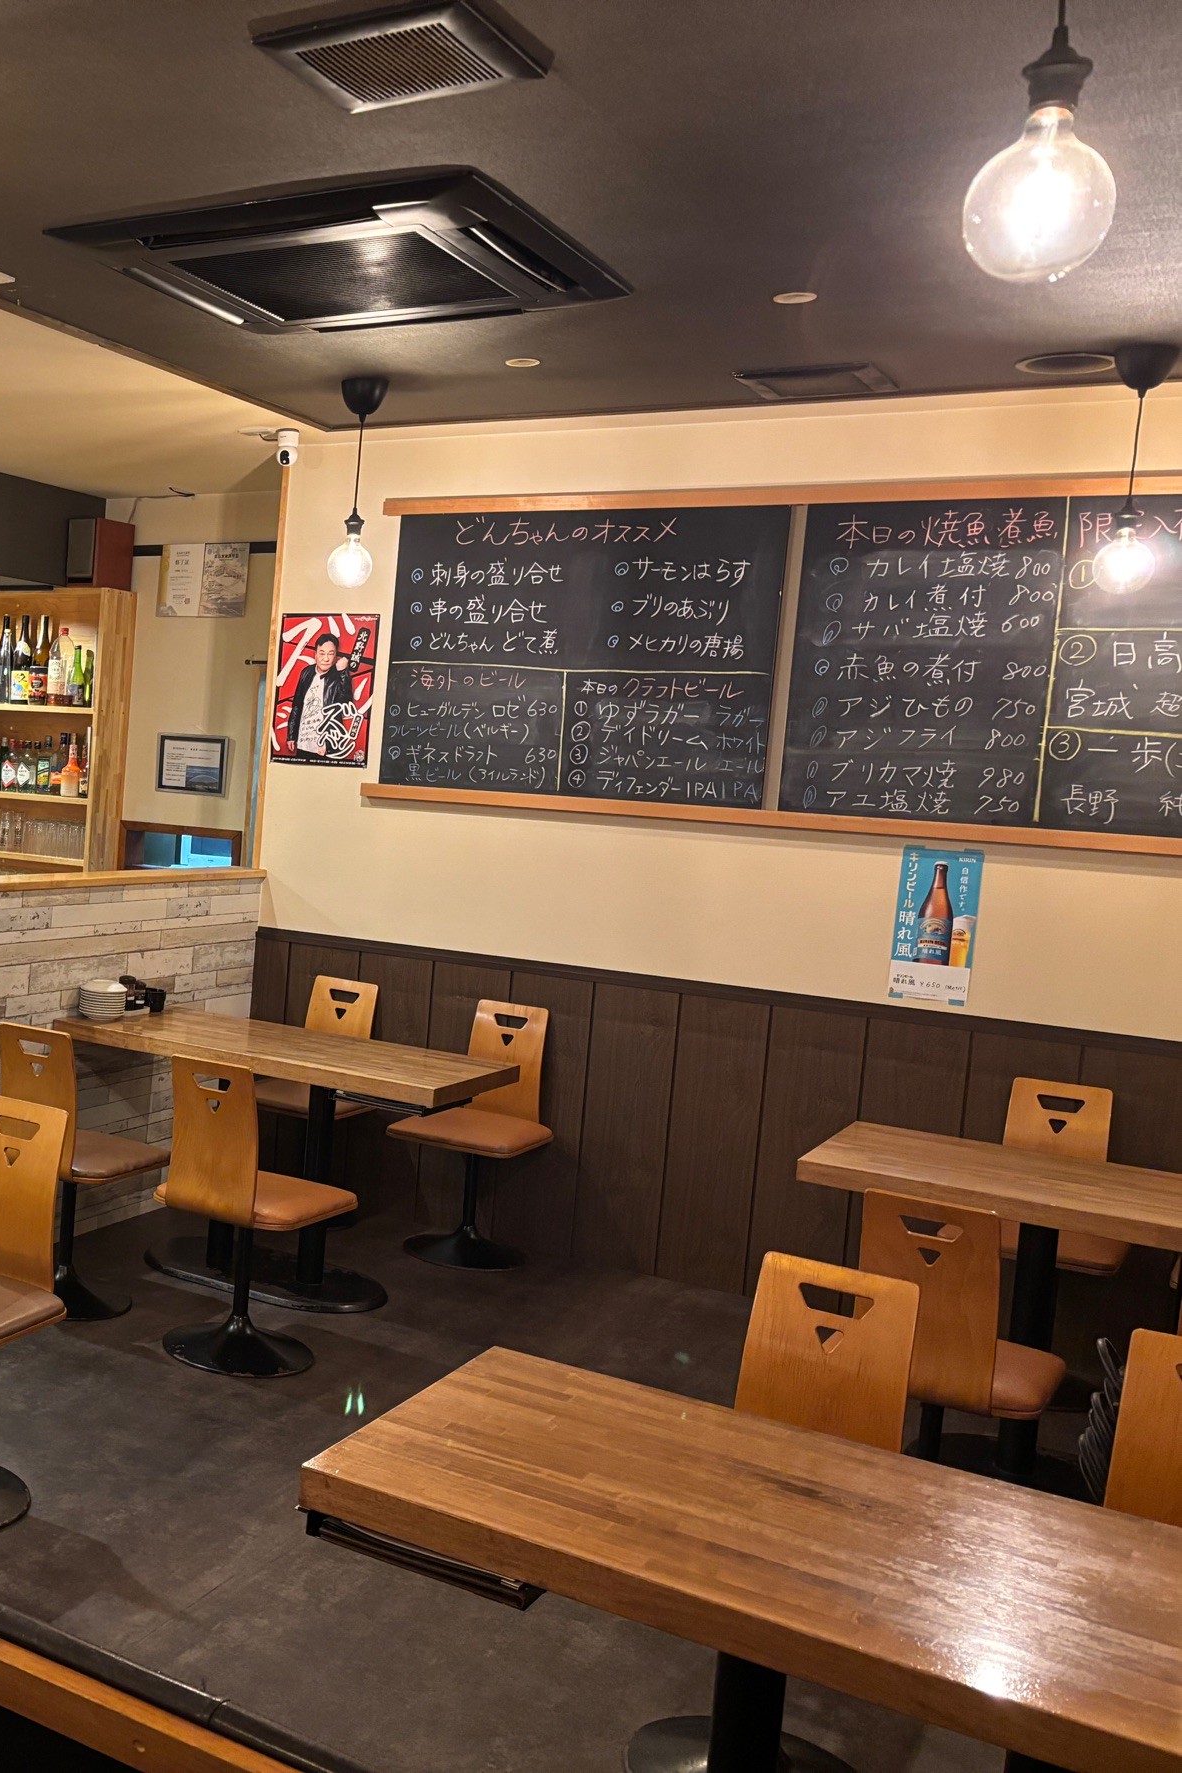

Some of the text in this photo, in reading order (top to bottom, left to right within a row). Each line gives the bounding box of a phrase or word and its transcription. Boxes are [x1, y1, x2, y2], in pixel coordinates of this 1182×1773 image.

[456, 517, 679, 546] どんちゃんのオススメ
[429, 557, 564, 588] 刺身の盛り合せ
[631, 556, 752, 588] サーモンはらす
[866, 552, 1051, 579] カレイ塩焼 800
[429, 596, 548, 626] 串の盛り合せ
[631, 597, 730, 626] ブリのあぶり
[863, 584, 1054, 612] カレイ煮付 800
[851, 612, 1040, 639] サバ塩焼 600
[349, 631, 368, 670] 北野誠の
[429, 629, 558, 656] どんちゃん どて煮
[628, 634, 745, 660] メヒカリの唐揚
[409, 666, 527, 692] 海外のビール
[836, 654, 1047, 686] 赤魚の煮付 800
[527, 702, 558, 716] 630
[836, 695, 1036, 721] アジひもの 750
[836, 725, 1026, 749] アジフライ 800
[405, 746, 557, 765] ギネスドラフト 630
[830, 759, 1025, 789] ブリカマ焼 980
[826, 789, 1020, 816] アユ塩焼 750
[1060, 784, 1119, 825] 長野
[893, 852, 919, 958] キリンビール 晴れ風
[893, 977, 916, 986] 晴れ風
